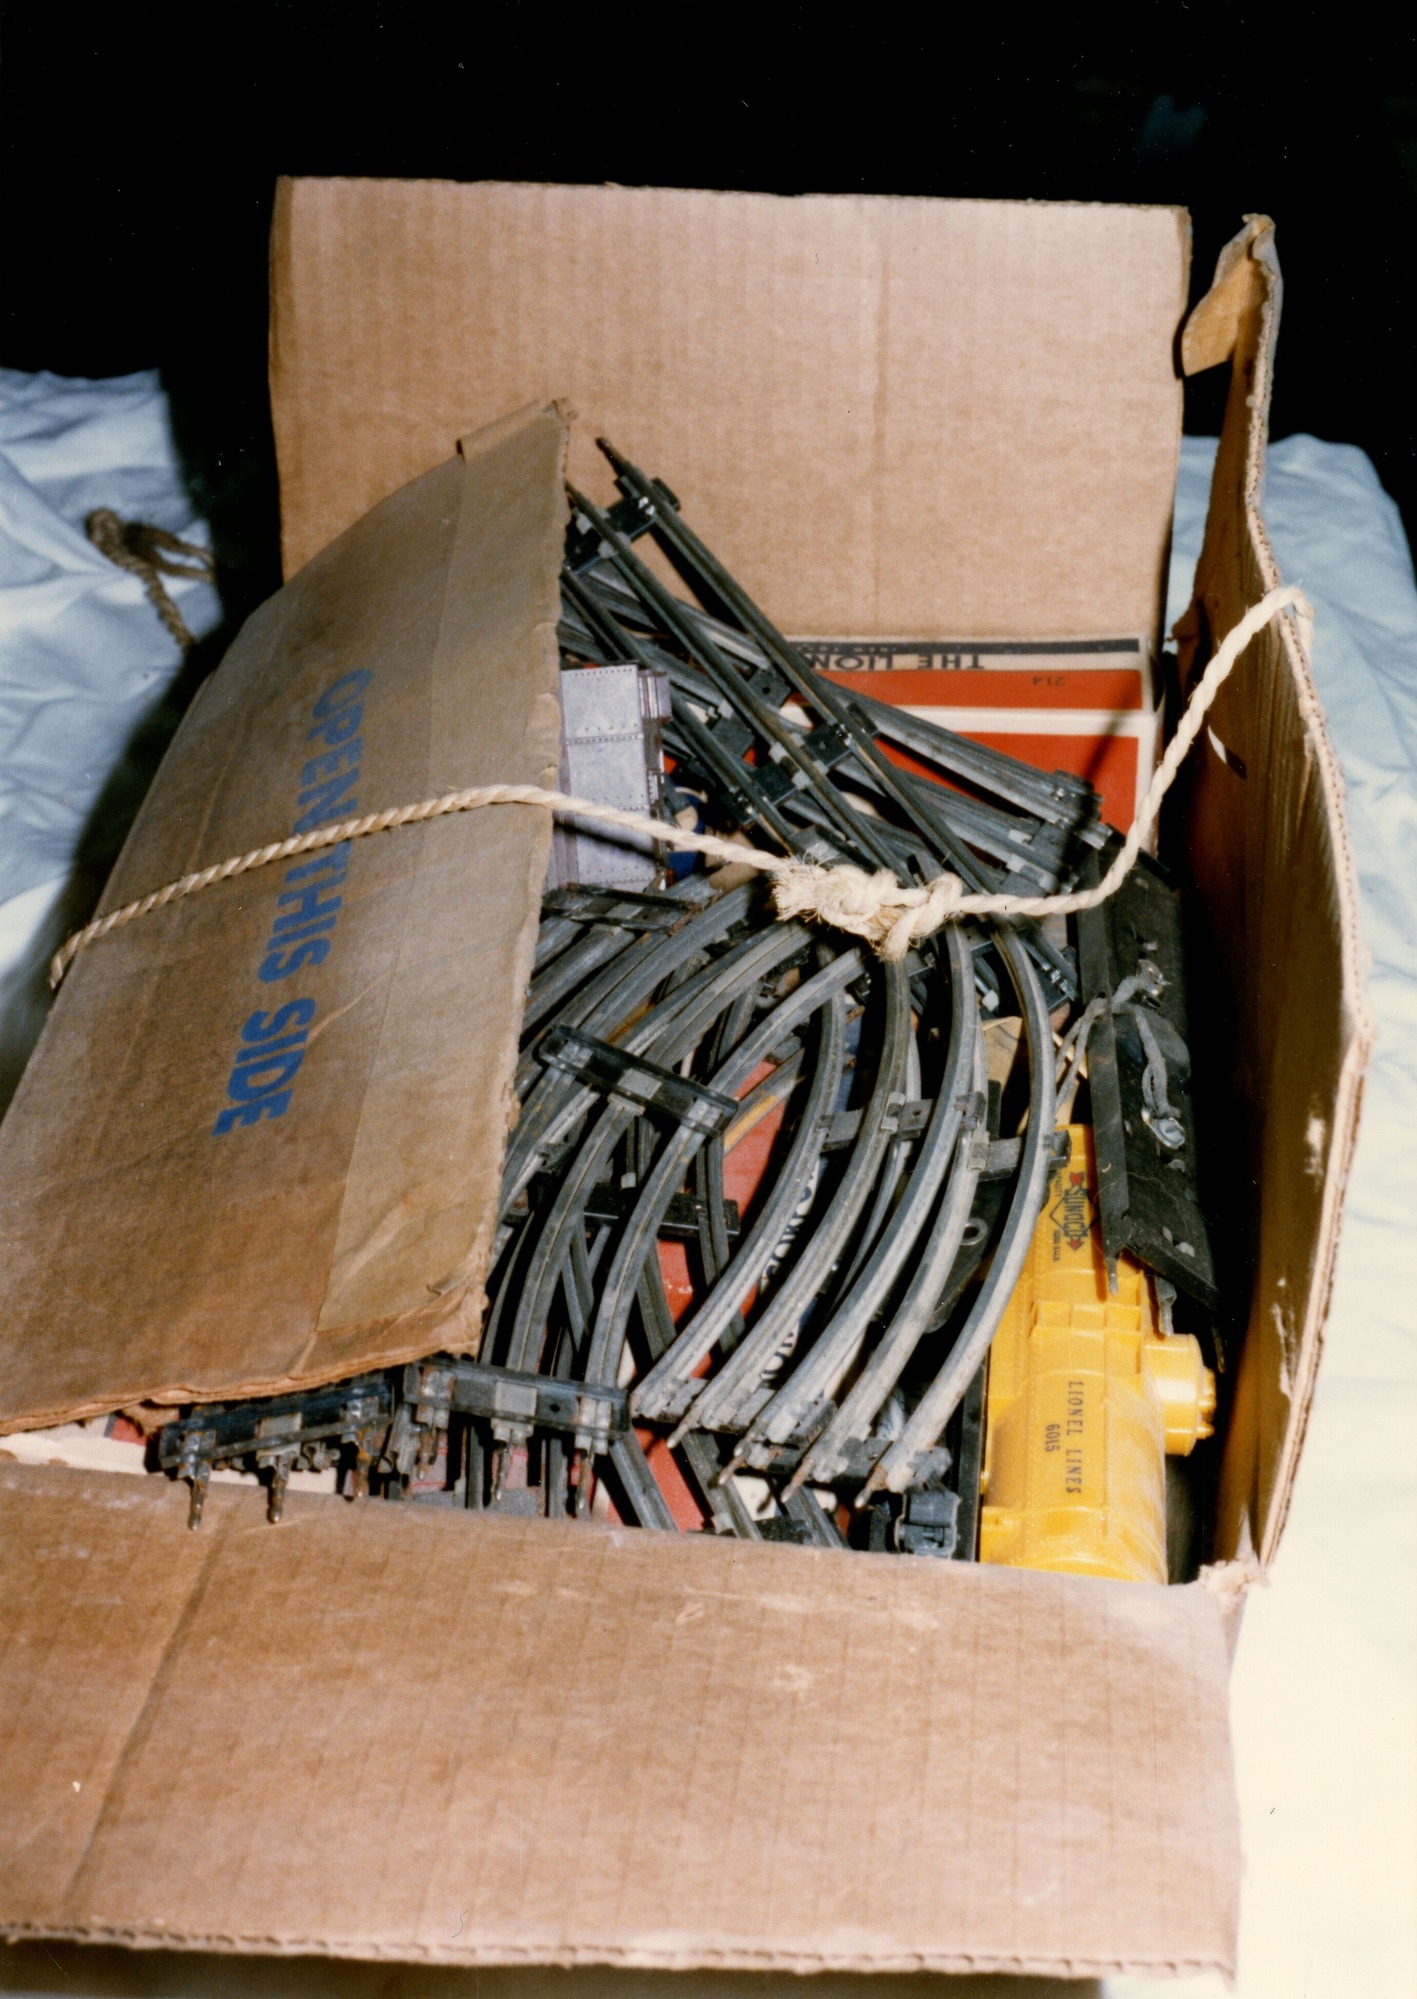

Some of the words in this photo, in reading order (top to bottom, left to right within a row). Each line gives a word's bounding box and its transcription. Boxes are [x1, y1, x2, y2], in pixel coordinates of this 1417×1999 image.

[806, 653, 893, 671] LION
[917, 653, 984, 671] THE
[1032, 676, 1065, 687] 214
[293, 669, 374, 834] OPEN
[258, 839, 352, 983] THIS
[211, 998, 317, 1136] SIDE
[1064, 1187, 1089, 1237] SUNOCO
[1067, 1381, 1084, 1436] LIONEL
[1044, 1424, 1061, 1452] 6015
[1066, 1449, 1082, 1493] LINES
